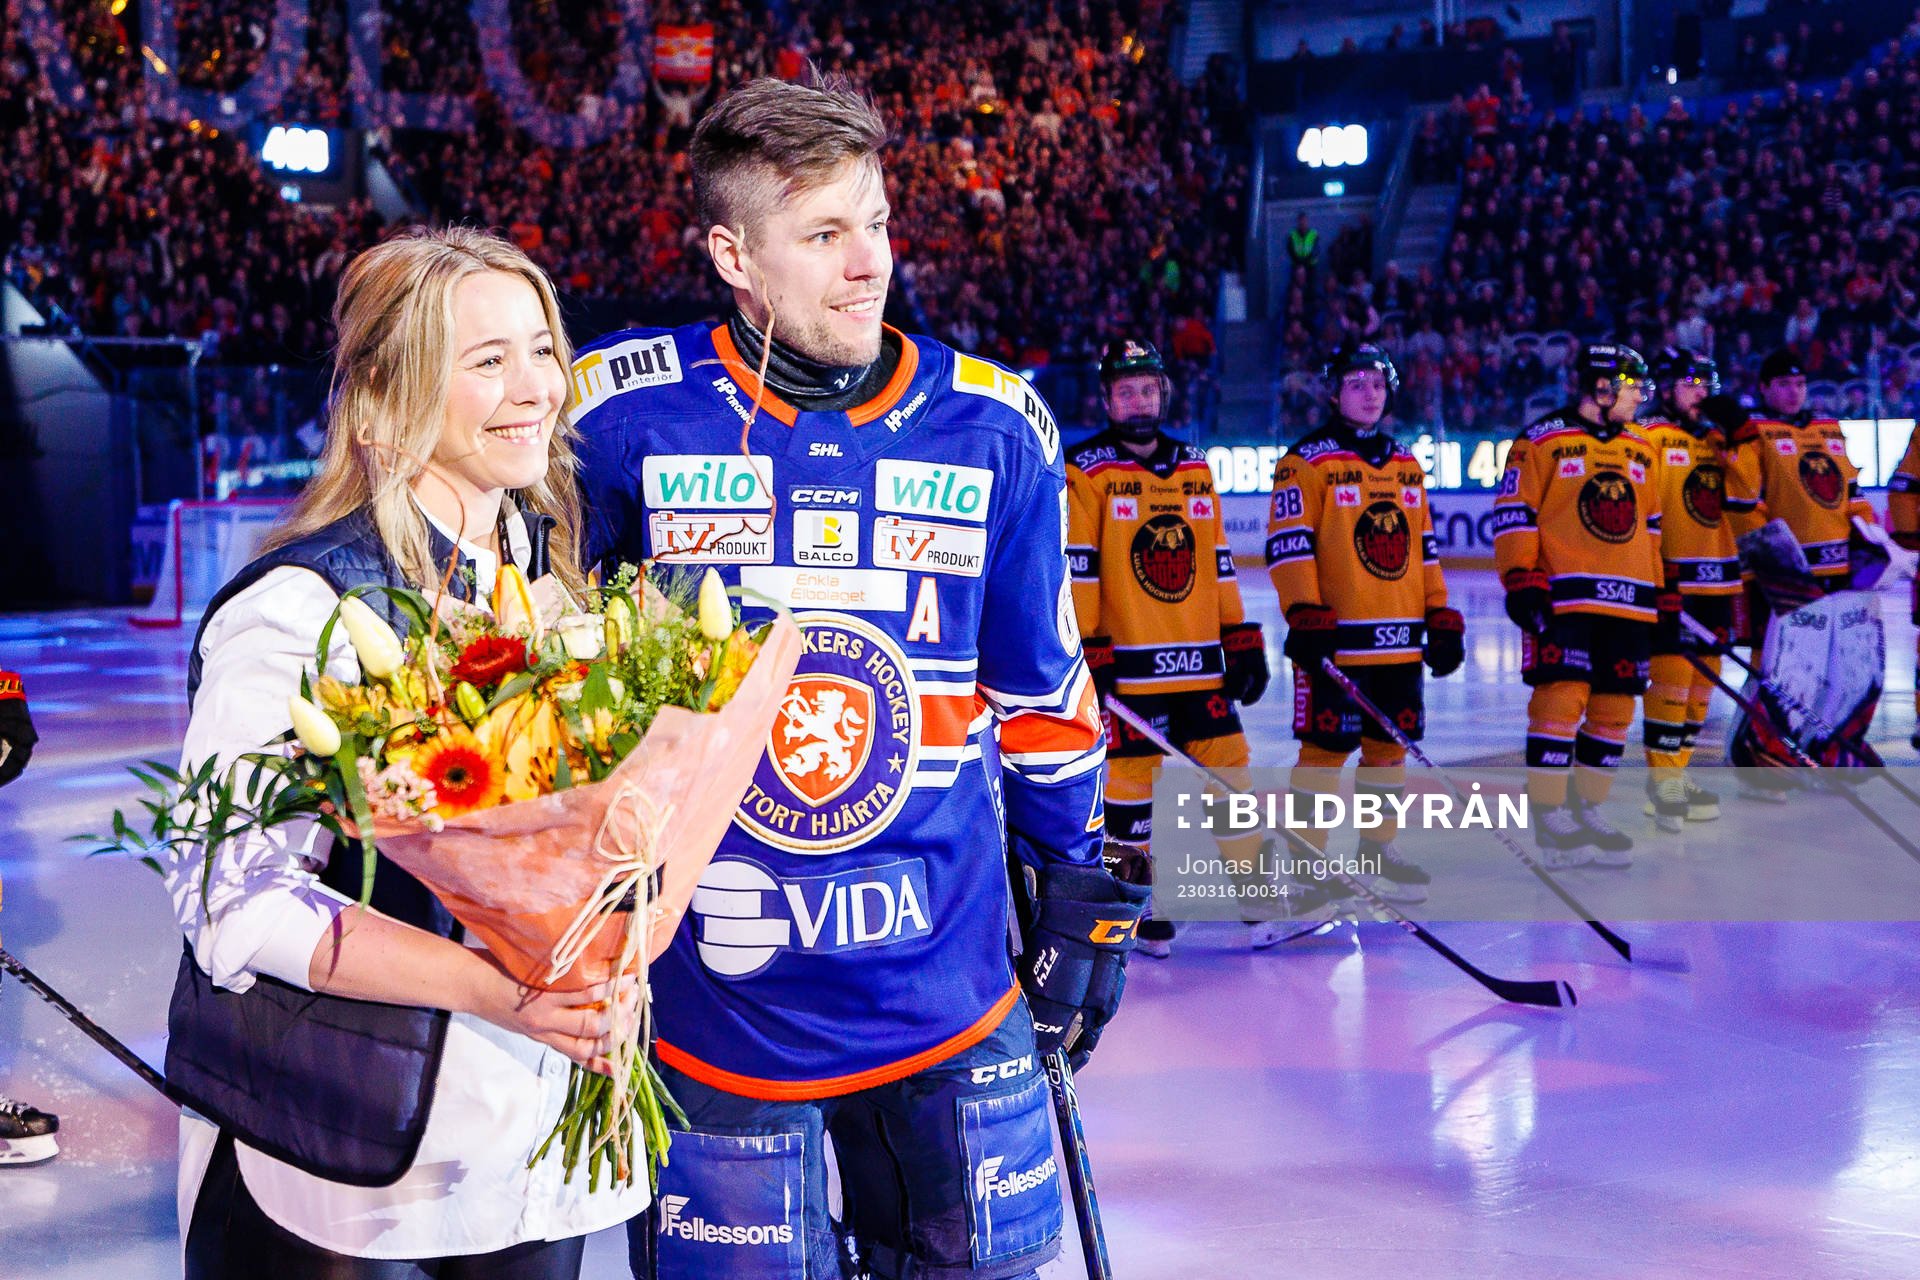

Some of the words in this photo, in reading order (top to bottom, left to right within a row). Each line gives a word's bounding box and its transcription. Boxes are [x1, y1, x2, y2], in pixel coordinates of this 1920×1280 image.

[609, 342, 671, 390] put
[627, 373, 673, 387] interiör
[808, 442, 844, 457] SHL
[659, 461, 756, 503] wilo
[892, 470, 982, 514] wilo
[790, 489, 860, 505] CCM
[1275, 487, 1304, 521] 38
[799, 551, 854, 562] BALCO
[927, 550, 981, 569] PRODUKT
[1070, 556, 1089, 572] AB
[796, 573, 841, 587] Enkla
[1596, 581, 1636, 603] SSAB
[790, 586, 866, 604] Elbolaget
[905, 576, 941, 644] A
[1375, 626, 1411, 647] SSAB
[1154, 651, 1204, 675] SSAB
[800, 630, 865, 660] KERS
[864, 651, 910, 745] HOCKEY
[742, 783, 806, 833] TORT
[811, 782, 896, 836] HJÄRTA
[783, 874, 929, 949] VIDA
[1034, 1021, 1064, 1034] CM
[970, 1054, 1033, 1087] CCM
[986, 1156, 1058, 1201] Fellessons
[666, 1212, 794, 1247] Fellessons
